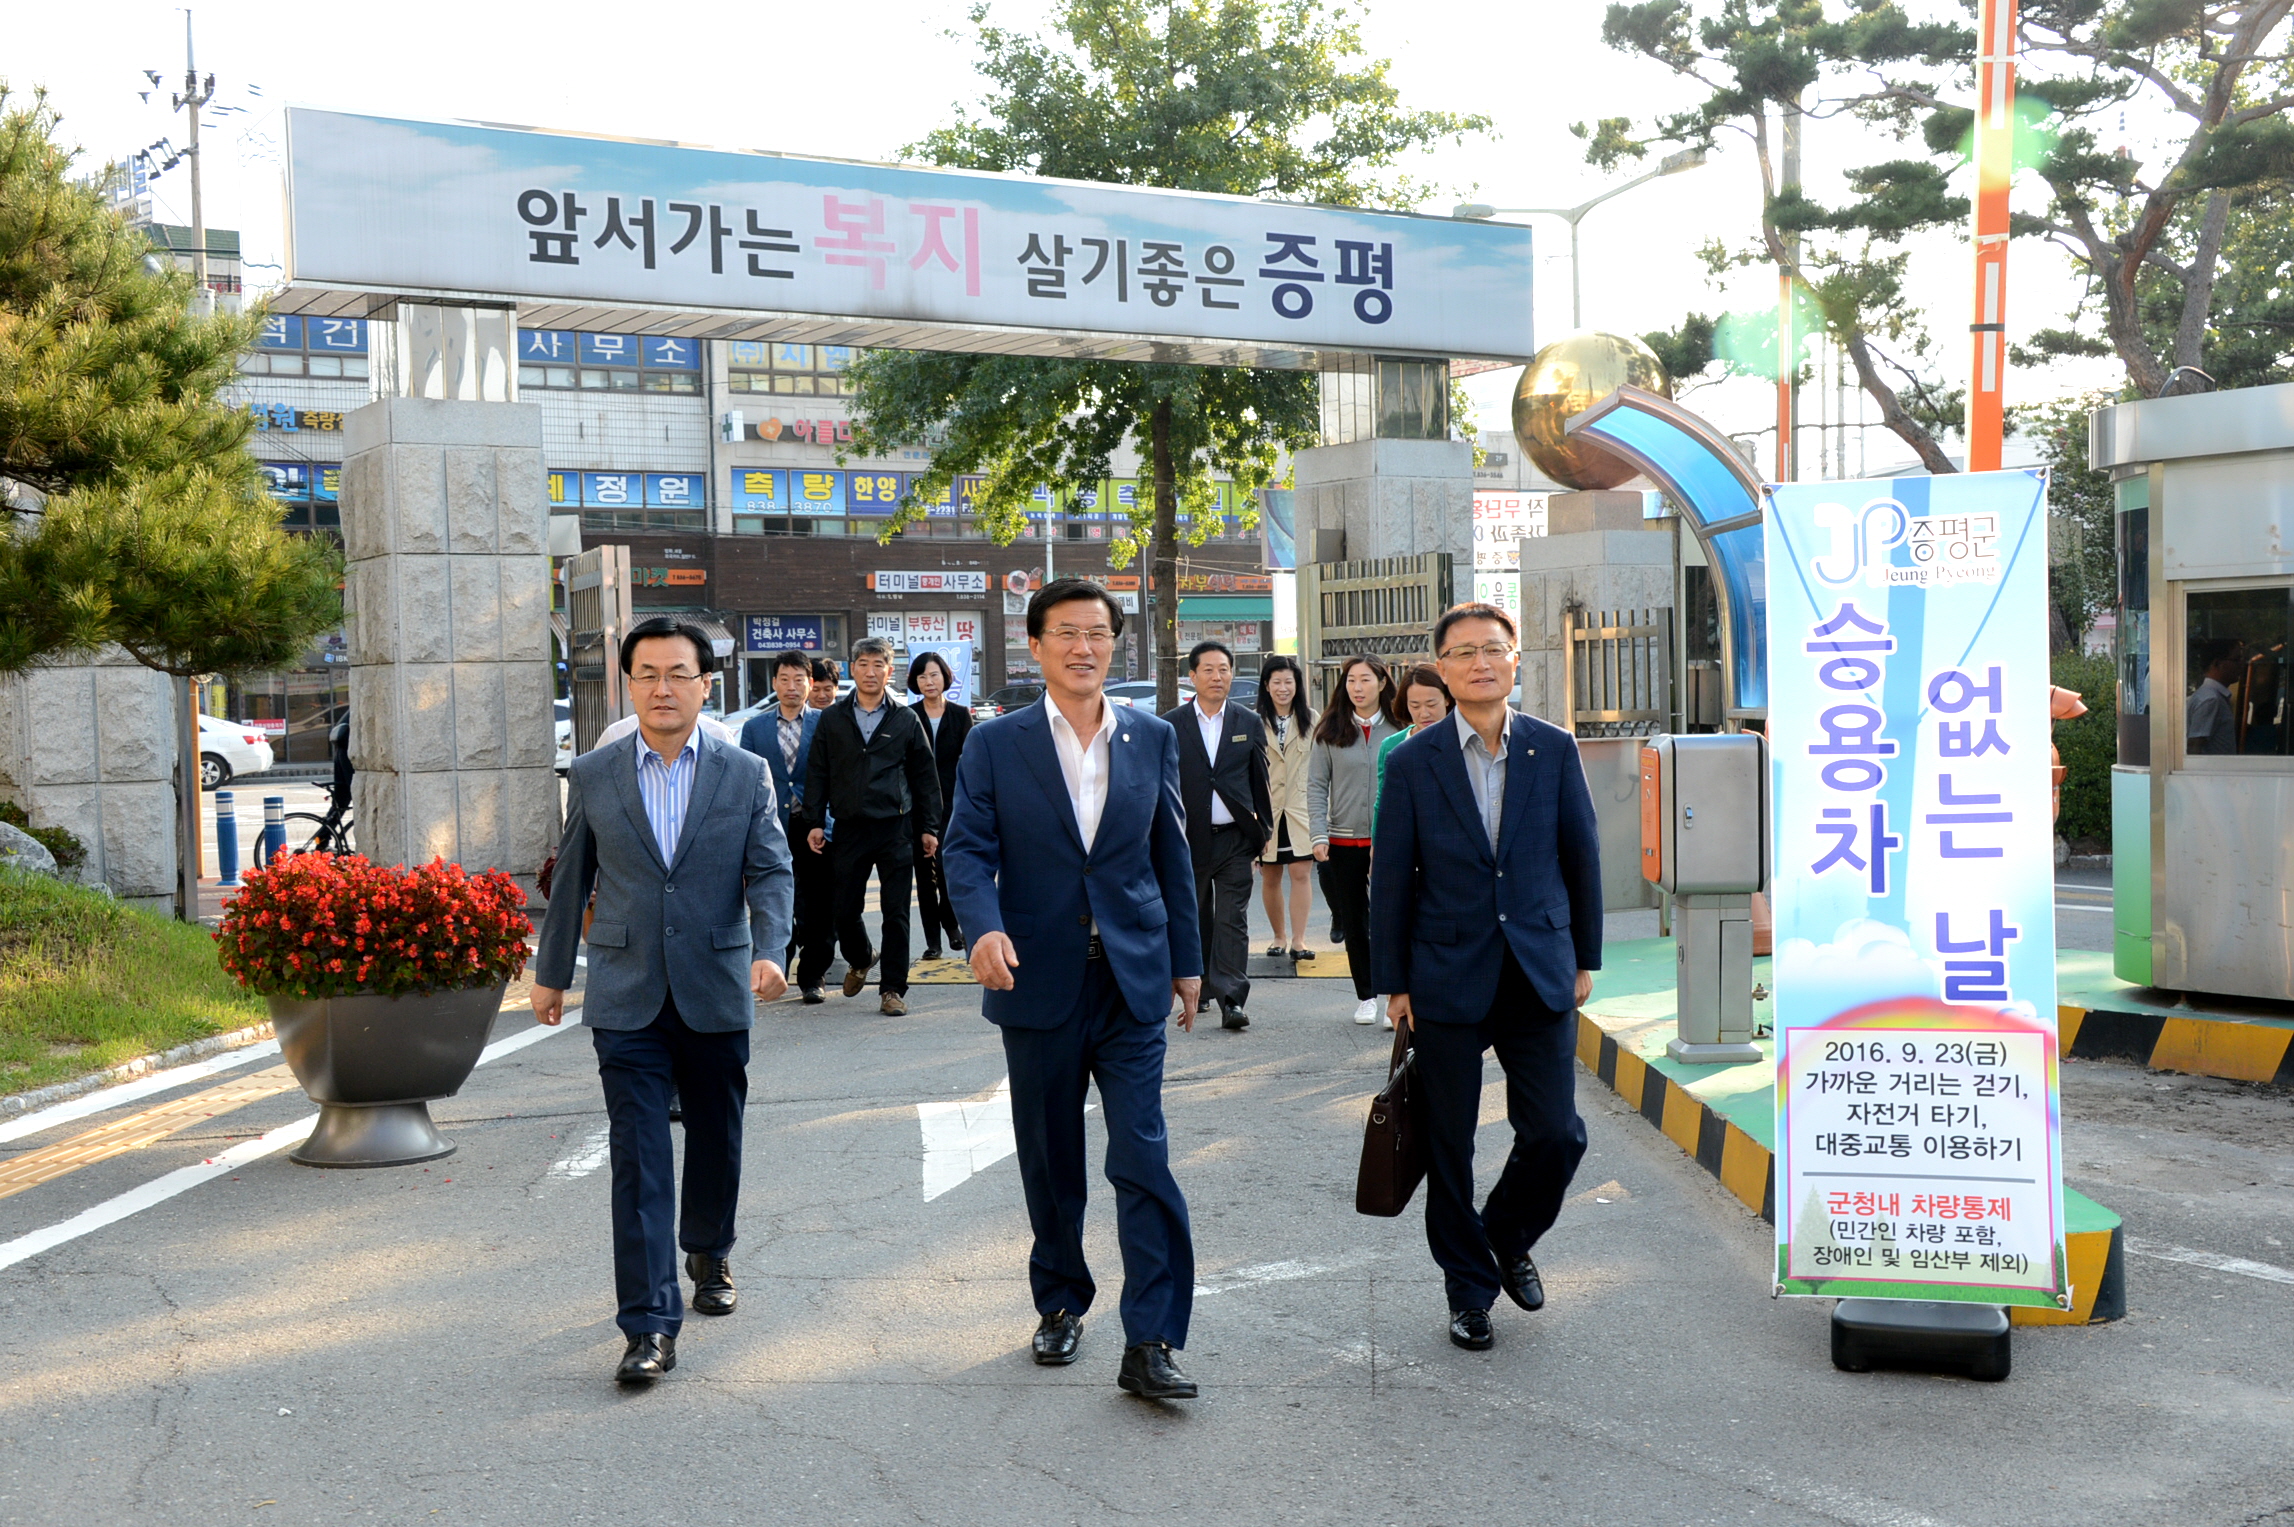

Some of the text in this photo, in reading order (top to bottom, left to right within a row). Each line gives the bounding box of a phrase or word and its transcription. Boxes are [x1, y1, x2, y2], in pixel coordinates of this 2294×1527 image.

[517, 189, 1393, 325] 앞서가는 복지 살기좋은 증평
[595, 475, 690, 505] 정원
[744, 472, 834, 500] 측량
[854, 476, 897, 502] 한양
[747, 500, 833, 513] 838-3870
[1911, 516, 1996, 562] 증평군
[879, 574, 919, 589] 터미널
[944, 574, 983, 589] 사무소
[1883, 568, 1929, 584] Jeung
[752, 627, 817, 640] 건축사 사무소
[908, 616, 945, 632] 부동산
[1806, 602, 1899, 894] 승용차
[1925, 665, 2018, 1003] 없는 날
[1824, 1040, 2008, 1067] 2016. 9. 23(금)
[1805, 1071, 2029, 1100] 가까운 거리는 걷기,
[1846, 1102, 1987, 1130] 자전거 타기,
[1815, 1132, 2022, 1162] 대중교통 이용하기
[1826, 1191, 2012, 1222] 군청내 차량통제
[1828, 1219, 2002, 1248] (민간인 차량 포함,
[1812, 1246, 2029, 1275] 장애인 및 임산부 제외)
